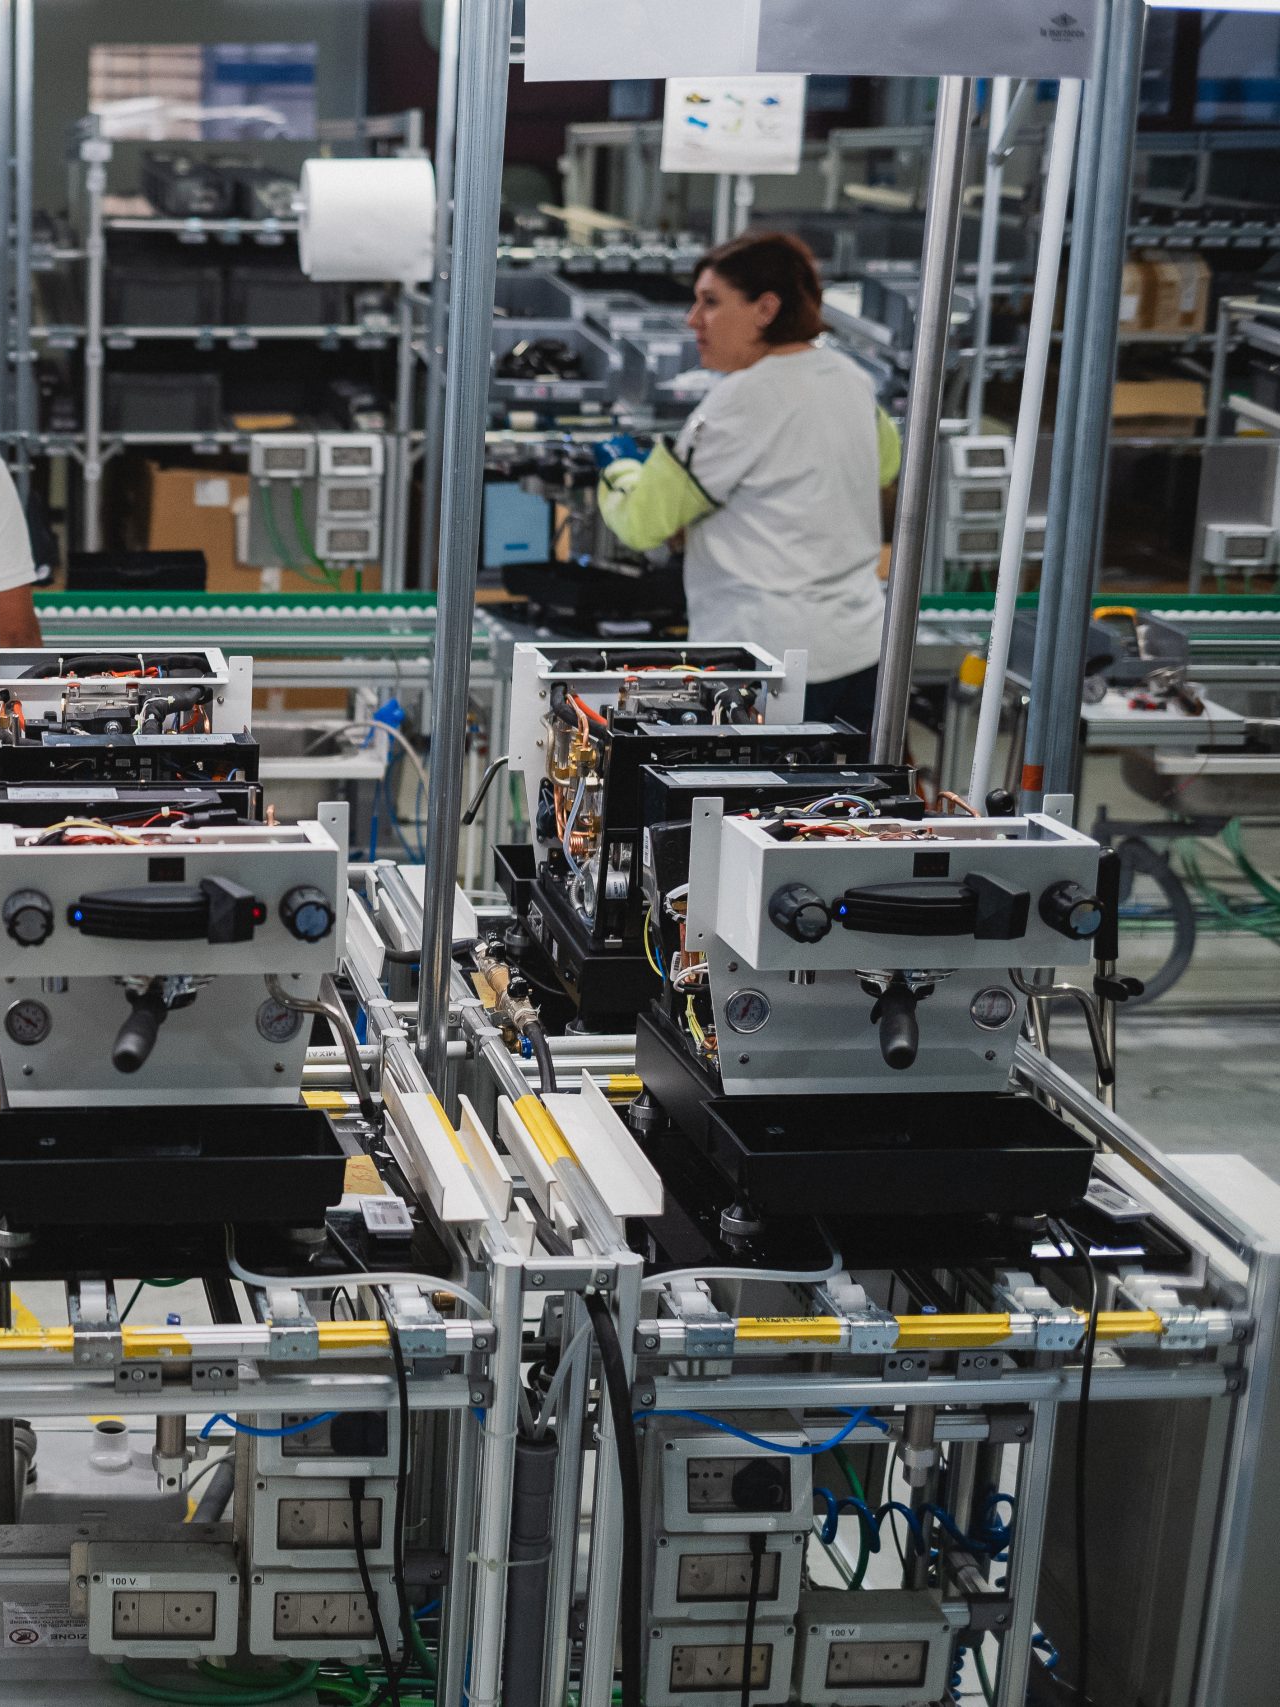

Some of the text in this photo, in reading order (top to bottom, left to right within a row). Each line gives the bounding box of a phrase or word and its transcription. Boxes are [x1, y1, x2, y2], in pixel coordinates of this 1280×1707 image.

[110, 1577, 127, 1586] 100
[830, 1628, 855, 1637] 100 V
